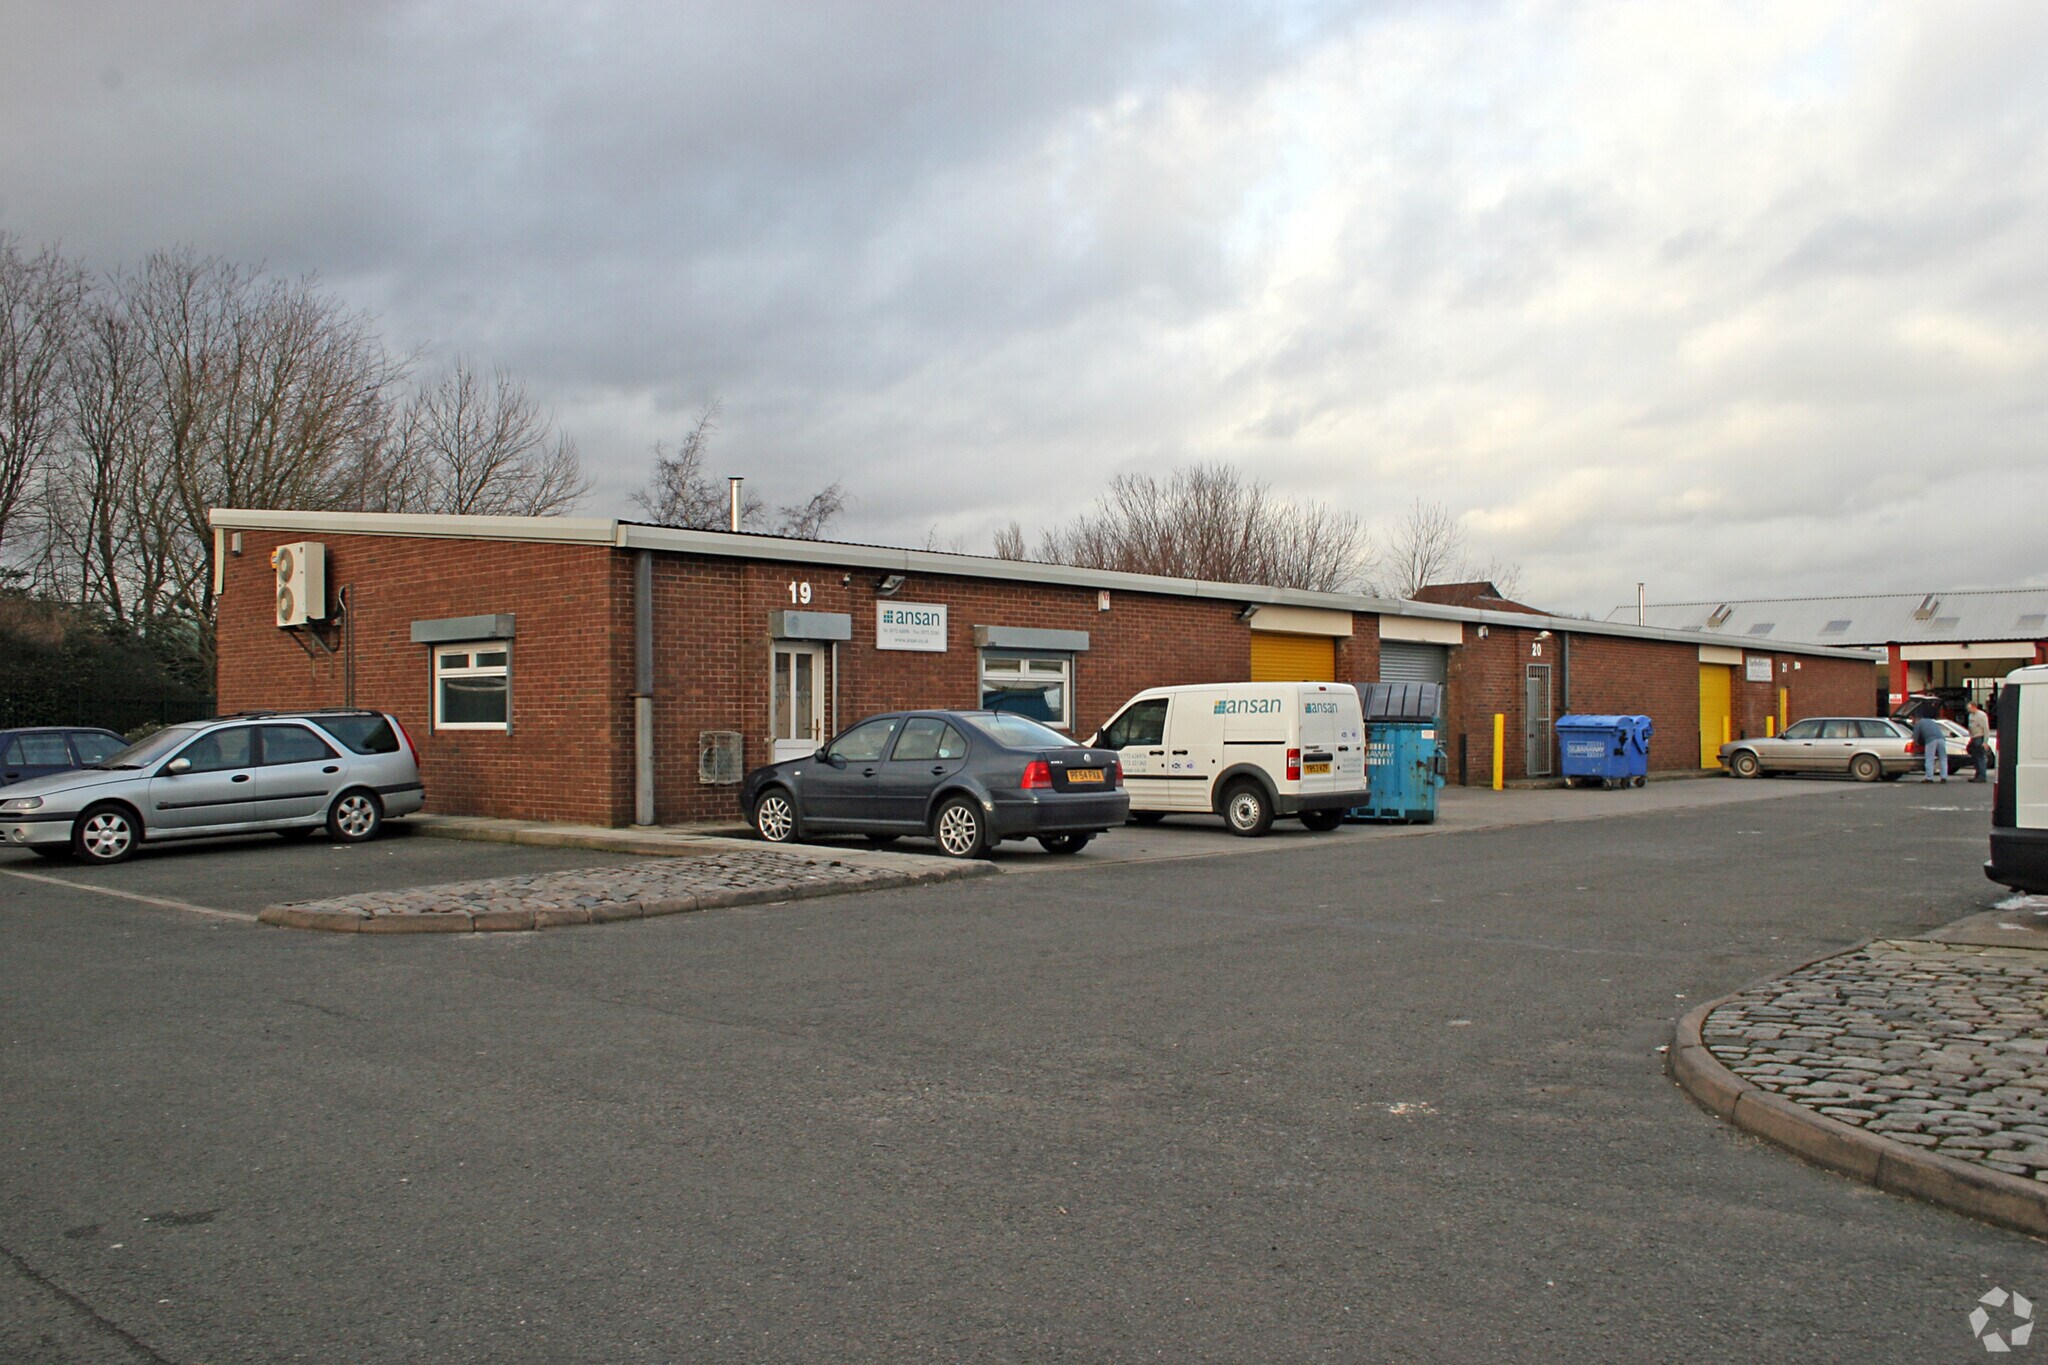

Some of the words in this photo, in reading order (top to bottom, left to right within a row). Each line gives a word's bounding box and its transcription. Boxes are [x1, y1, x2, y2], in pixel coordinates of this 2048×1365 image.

[789, 581, 812, 604] 19
[896, 610, 940, 627] ansan
[1532, 643, 1542, 657] 20
[1226, 698, 1282, 714] ansan
[1312, 702, 1338, 714] ansan
